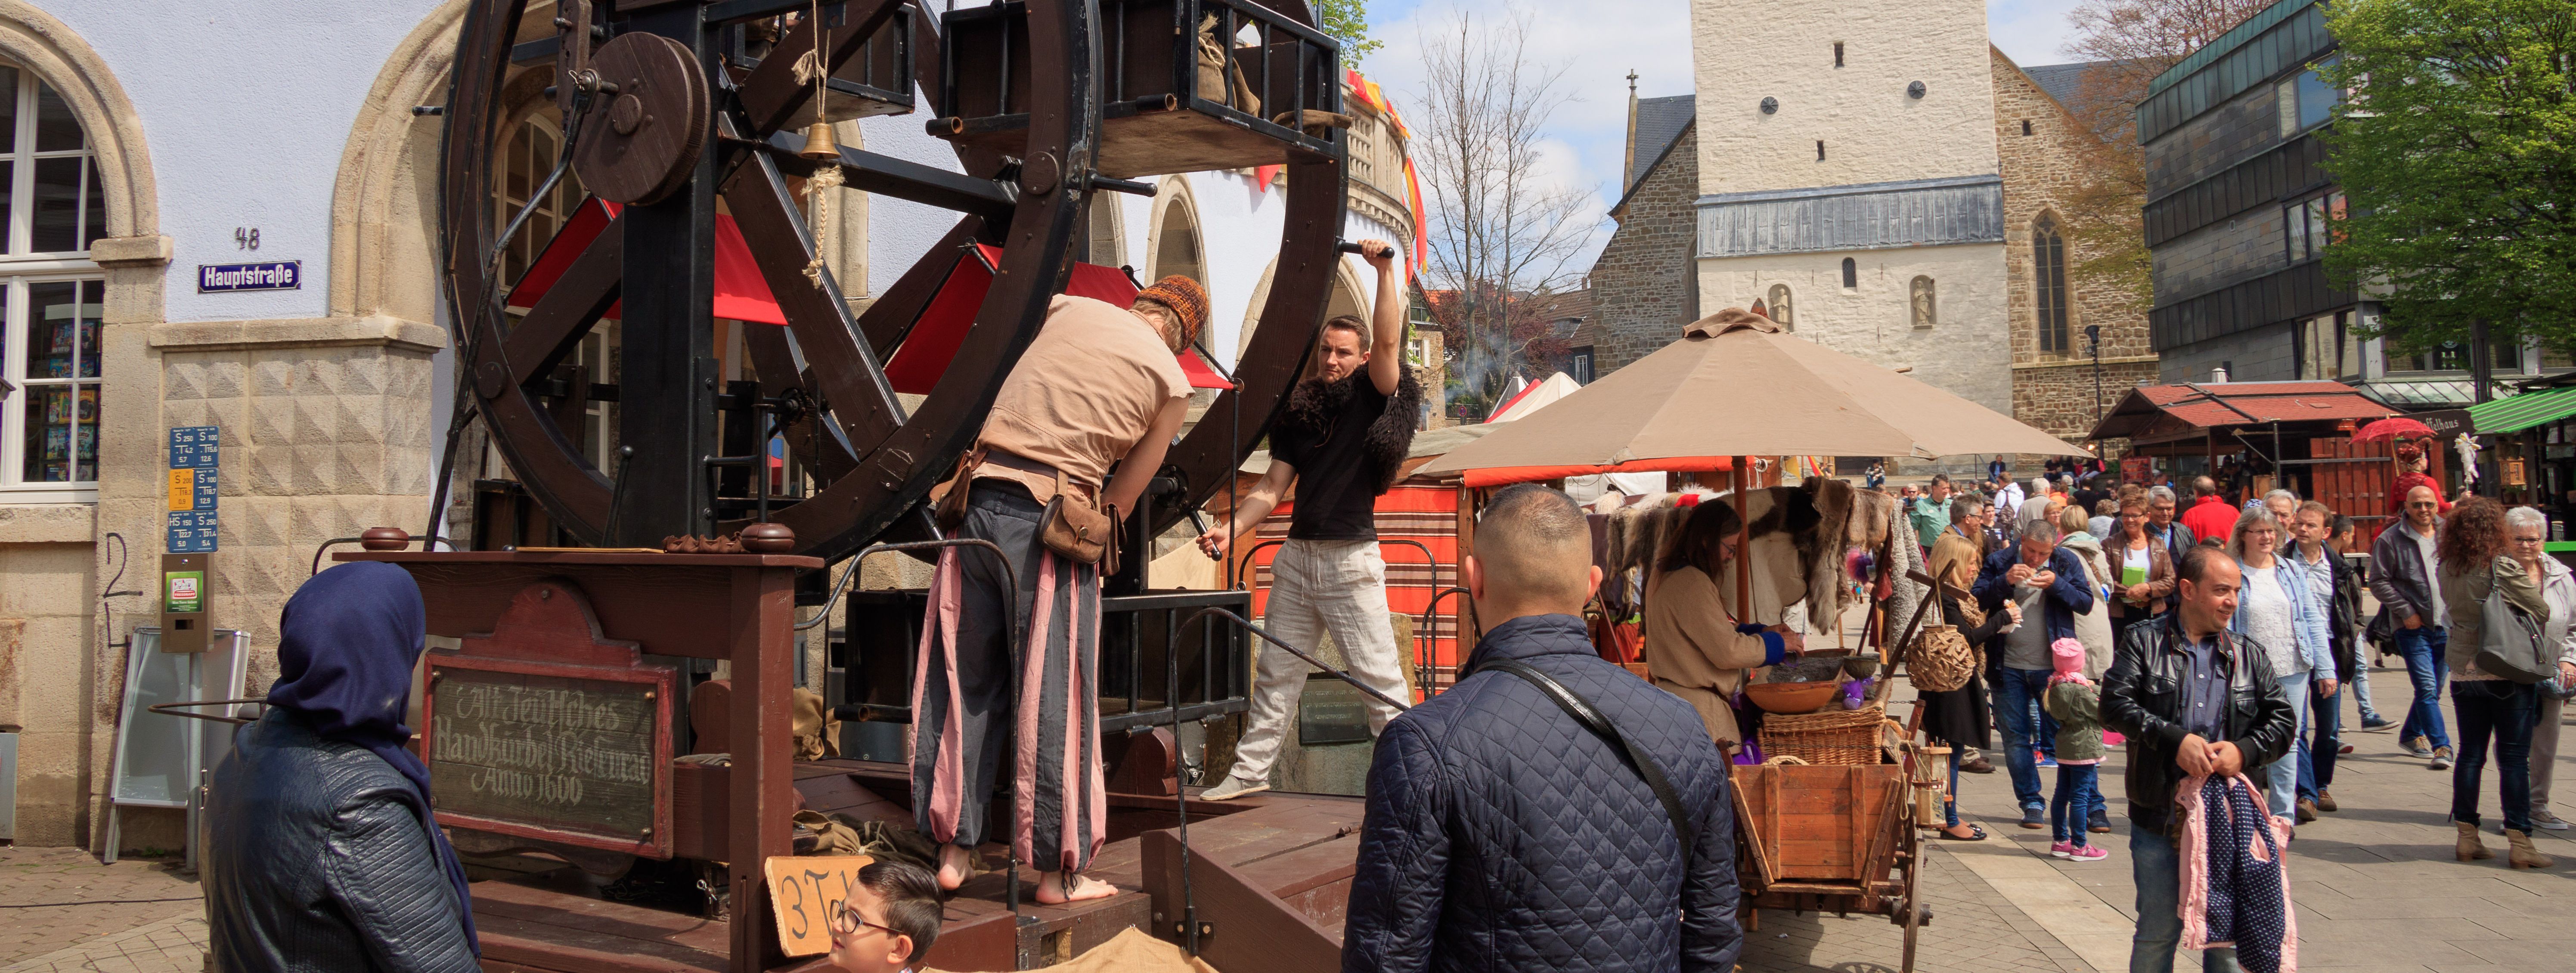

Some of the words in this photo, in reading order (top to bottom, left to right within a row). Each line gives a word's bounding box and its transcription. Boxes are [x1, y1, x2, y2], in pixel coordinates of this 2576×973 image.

[235, 227, 260, 250] 48
[205, 264, 293, 289] Hauptstraße
[176, 433, 182, 442] S
[200, 432, 206, 441] S
[175, 475, 180, 483] S
[199, 474, 205, 483] S
[169, 517, 180, 527] HS
[198, 516, 205, 525] S
[535, 774, 583, 806] 1600
